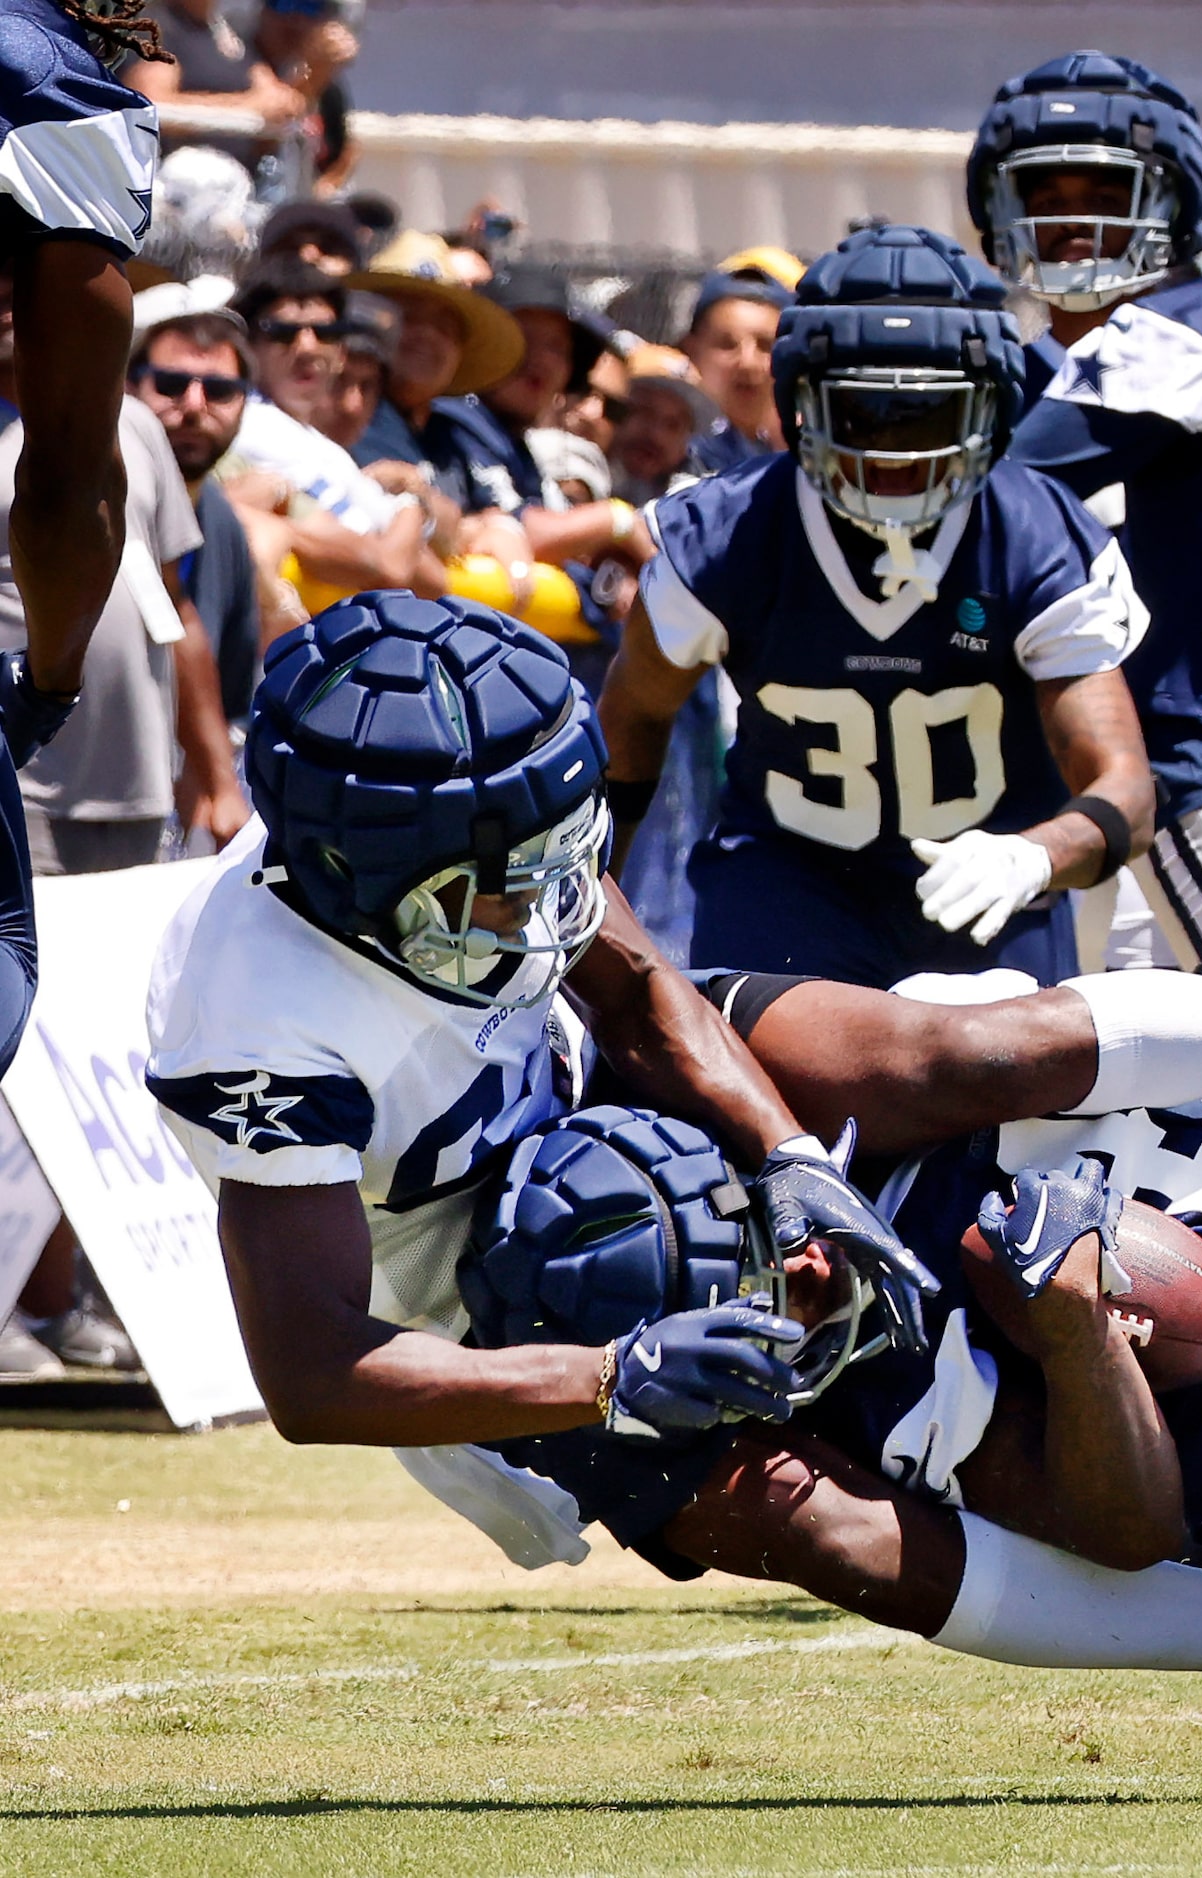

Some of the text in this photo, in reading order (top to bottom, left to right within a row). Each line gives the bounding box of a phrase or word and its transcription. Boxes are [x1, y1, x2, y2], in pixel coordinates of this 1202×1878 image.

[950, 631, 989, 652] AT&T
[757, 681, 1006, 851] 30
[475, 993, 526, 1053] COWBO
